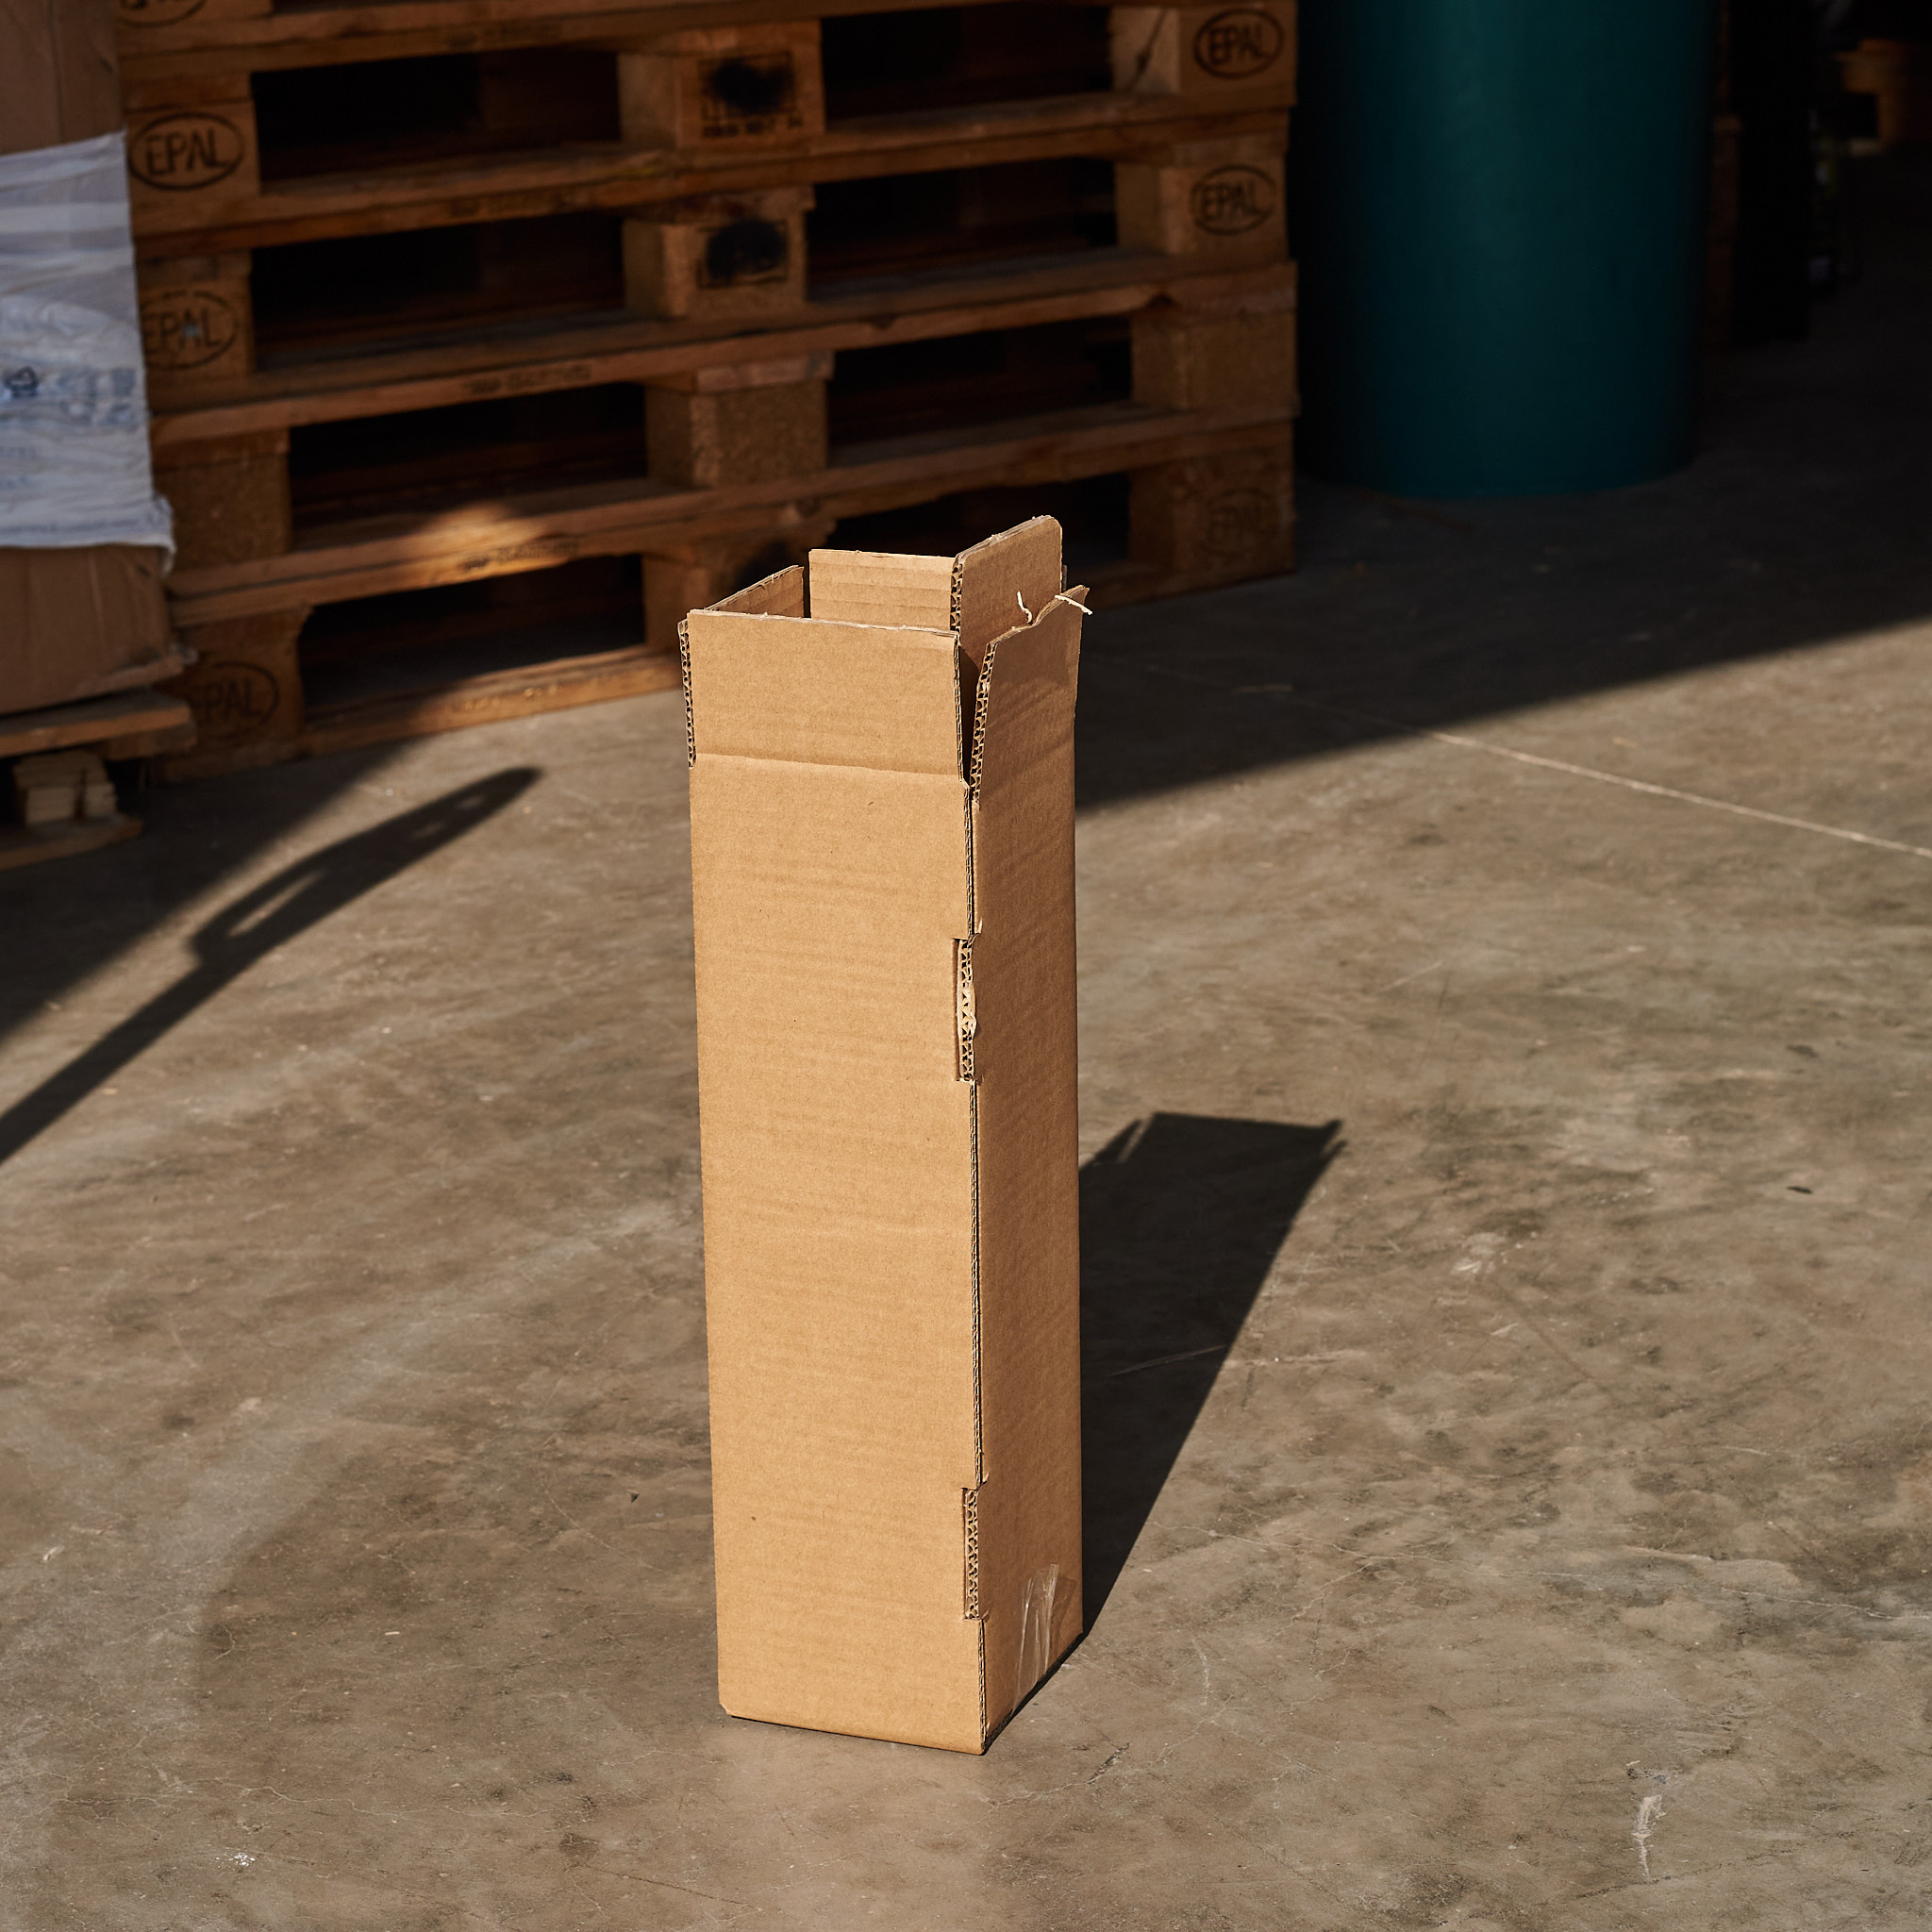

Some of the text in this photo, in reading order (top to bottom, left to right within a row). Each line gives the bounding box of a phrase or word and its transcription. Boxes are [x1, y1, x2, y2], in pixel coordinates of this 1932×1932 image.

[1209, 23, 1270, 64] EPAL
[146, 128, 232, 175] EPAL
[1202, 179, 1264, 221] EPAL
